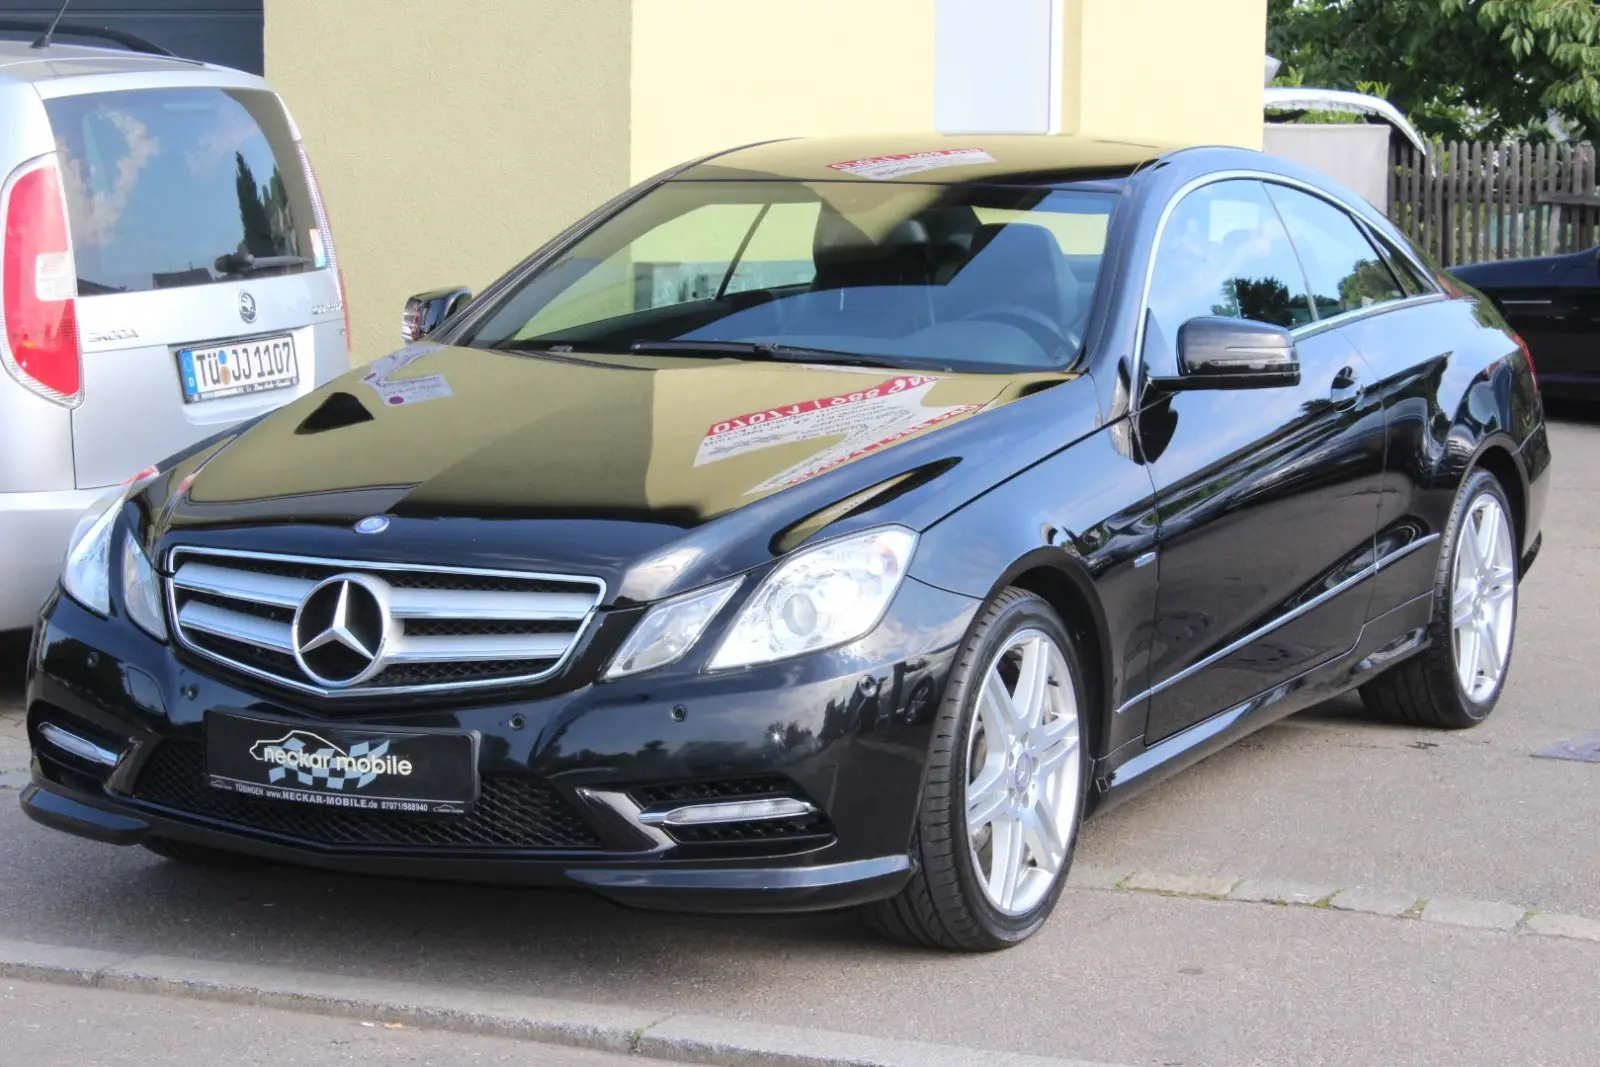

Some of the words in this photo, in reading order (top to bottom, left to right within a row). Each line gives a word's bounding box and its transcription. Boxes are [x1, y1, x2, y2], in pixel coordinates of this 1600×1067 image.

[196, 352, 221, 387] TÜ
[231, 347, 252, 382] JJ
[254, 341, 291, 378] 1107
[263, 747, 330, 769] neckar
[336, 754, 413, 776] mobile
[234, 782, 264, 797] TÜBINGEN
